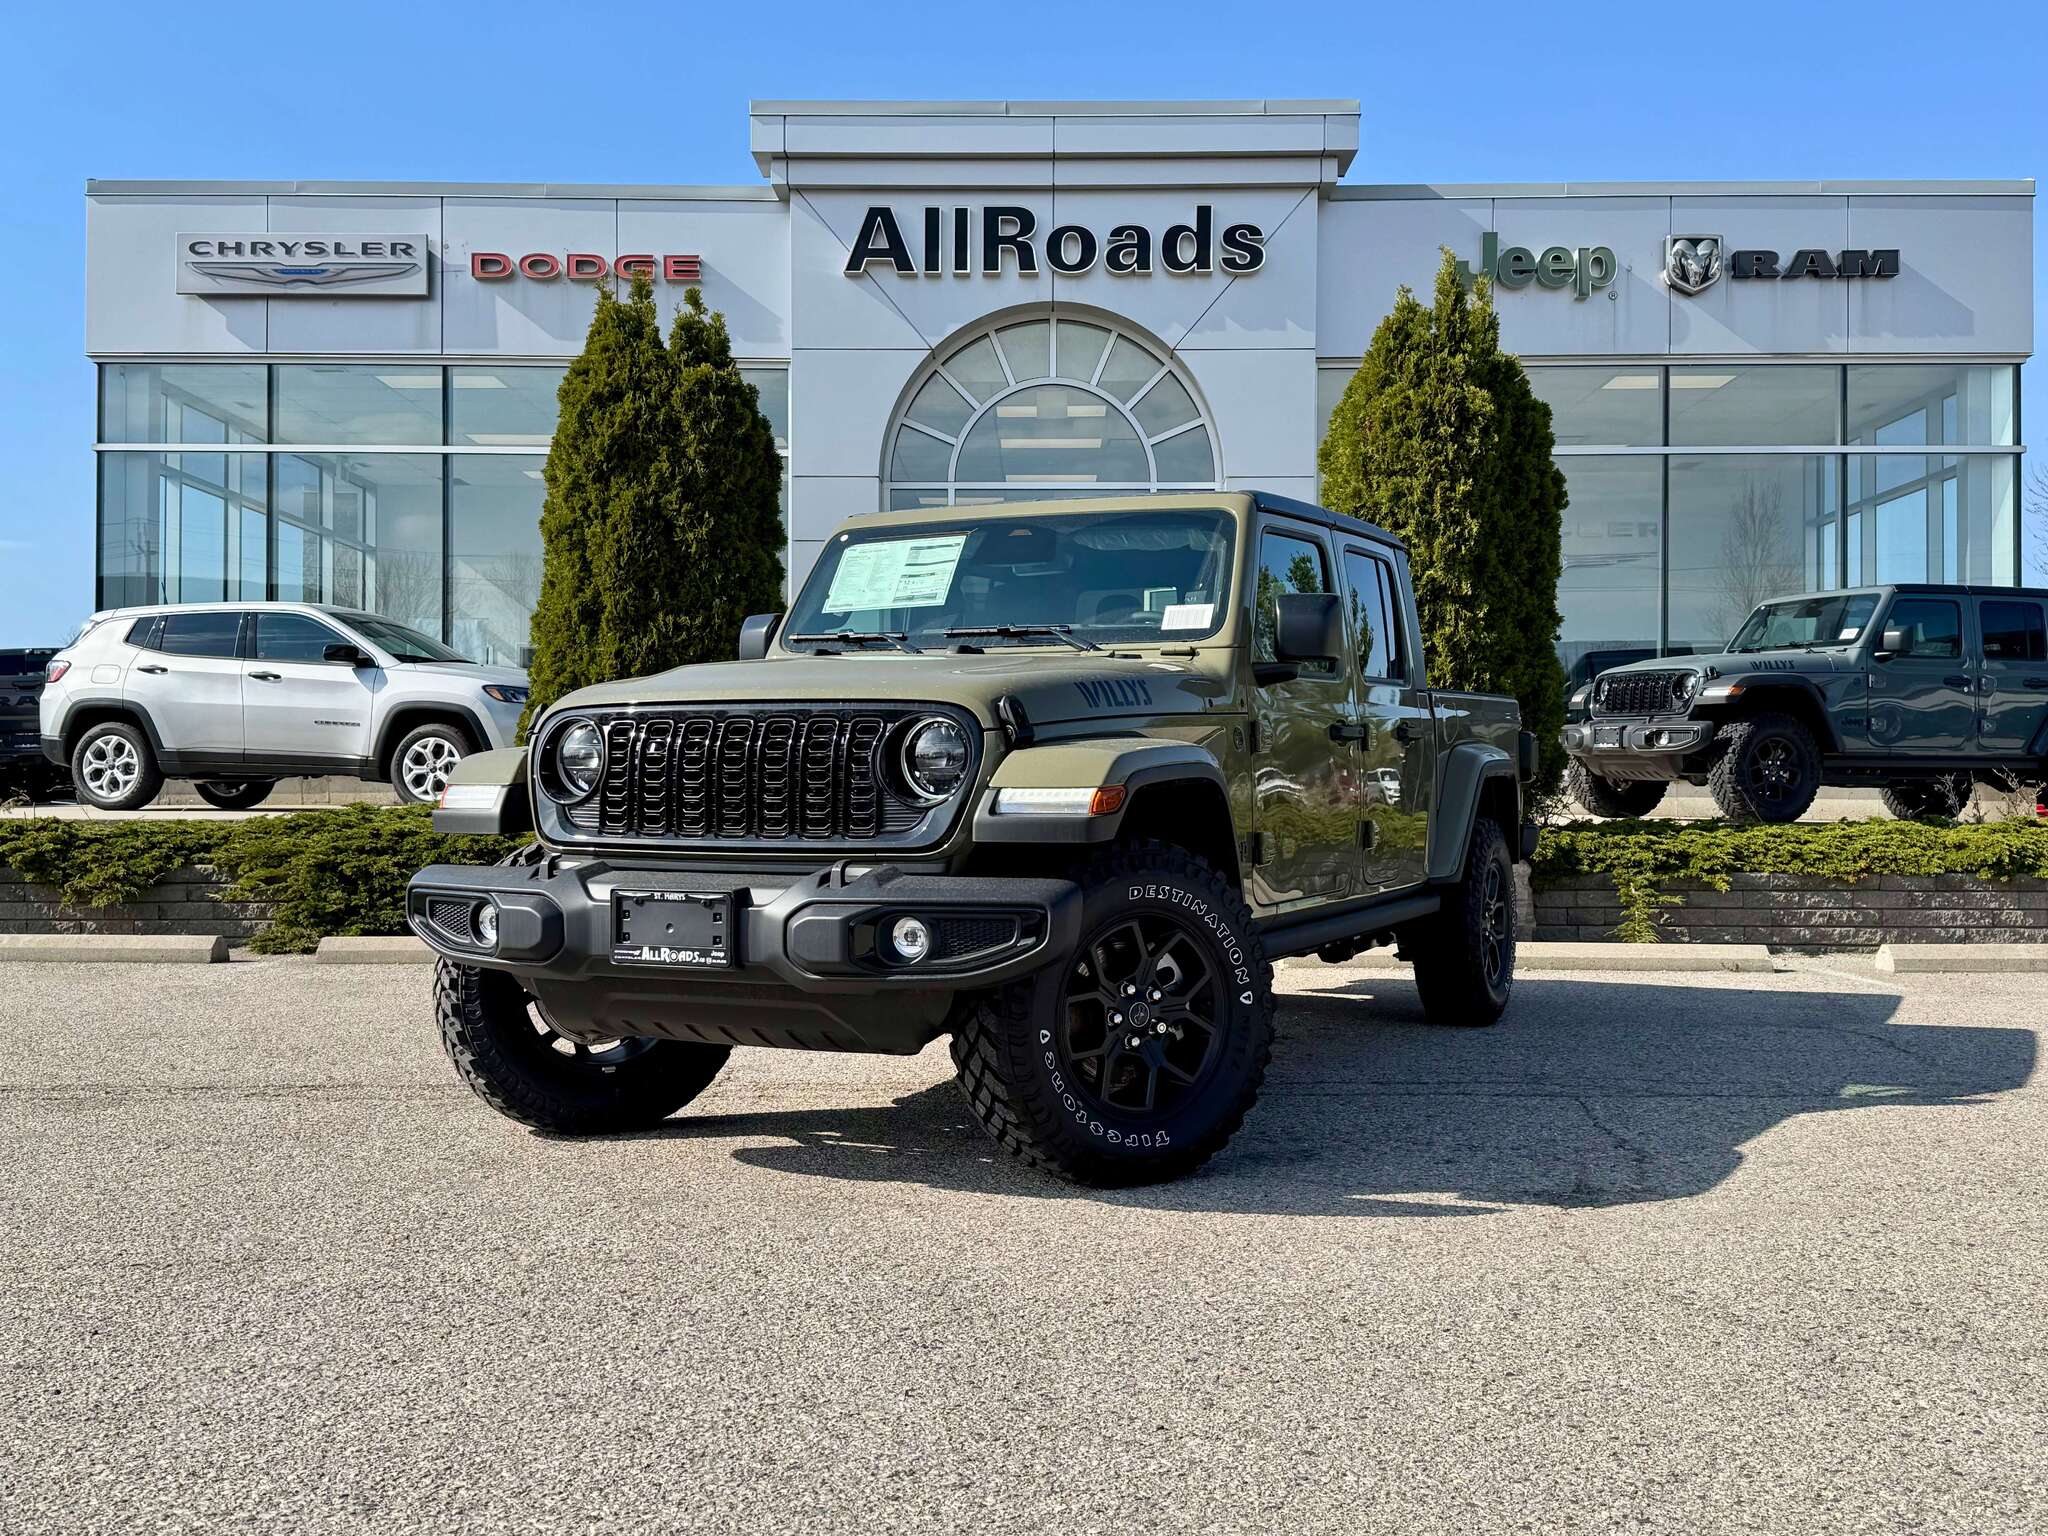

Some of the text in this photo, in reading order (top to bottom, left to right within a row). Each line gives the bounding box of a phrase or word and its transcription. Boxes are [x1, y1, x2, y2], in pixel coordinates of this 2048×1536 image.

[188, 241, 416, 258] CHRYSLER
[843, 204, 1267, 277] AllRoads
[471, 252, 701, 281] DODGE
[1456, 231, 1618, 300] Jeep
[1732, 249, 1900, 279] RAM
[1074, 680, 1152, 708] WILLYS
[1129, 885, 1250, 985] DESTINATION
